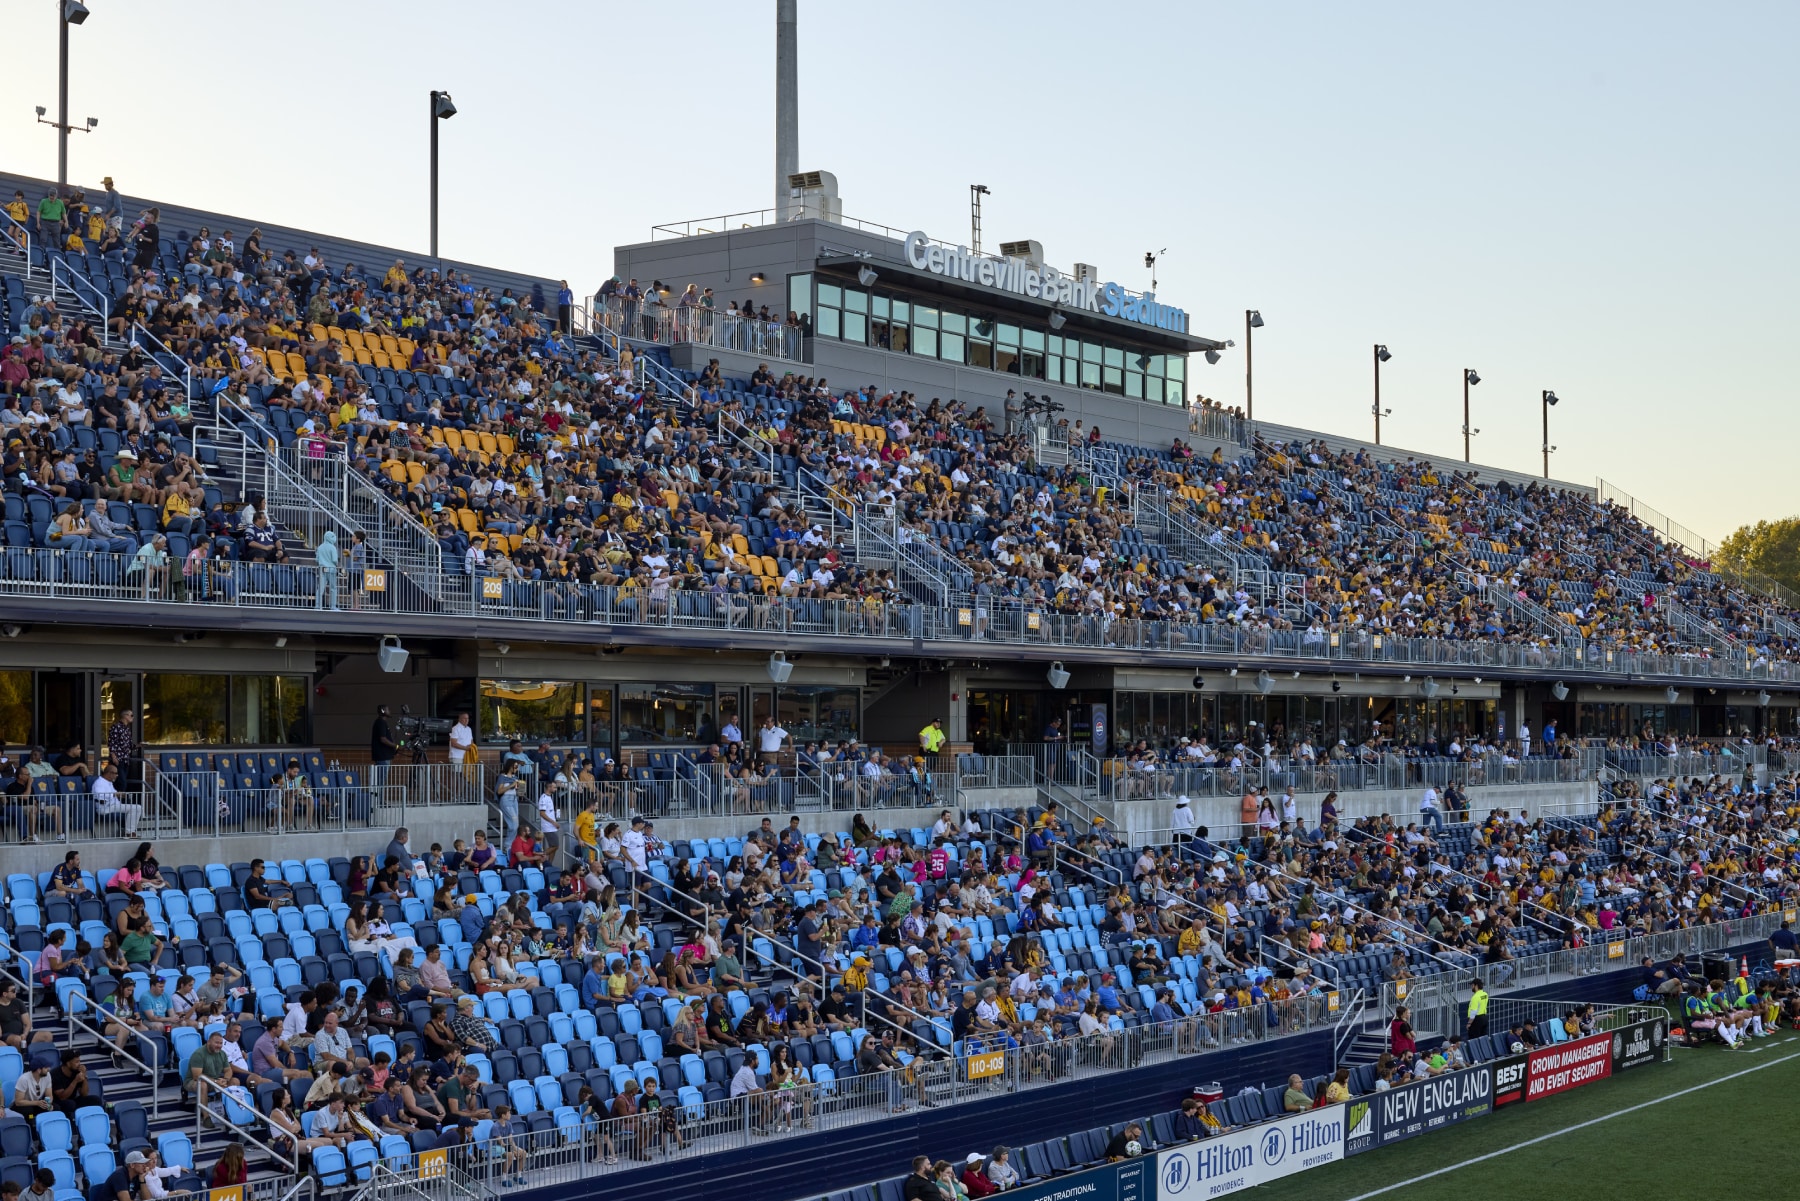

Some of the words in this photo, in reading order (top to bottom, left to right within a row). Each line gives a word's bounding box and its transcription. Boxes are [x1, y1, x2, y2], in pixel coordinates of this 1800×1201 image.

[904, 230, 1040, 298] Centreville
[1039, 262, 1099, 313] Bank
[1100, 281, 1185, 333] Stadium
[366, 574, 384, 587] 210
[483, 582, 502, 594] 209
[932, 859, 944, 872] 25
[1531, 1054, 1560, 1075] CROWD
[1561, 1040, 1610, 1067] MANAGEMENT
[1496, 1063, 1526, 1086] BEST
[1529, 1079, 1545, 1096] AND
[1547, 1069, 1571, 1090] EVENT
[1571, 1060, 1605, 1083] SECURITY
[1384, 1087, 1420, 1126] NEW
[1423, 1068, 1489, 1114] ENGLAND
[1291, 1119, 1342, 1155] Hilton
[1348, 1136, 1371, 1151] GROUP
[423, 1156, 445, 1175] 110
[1197, 1143, 1253, 1182] Hilton
[1302, 1151, 1333, 1167] PROVIDENCE
[1053, 1182, 1097, 1201] TRADITIONAL
[1123, 1183, 1136, 1191] LUNCH
[1210, 1177, 1244, 1195] PROVIDENCE
